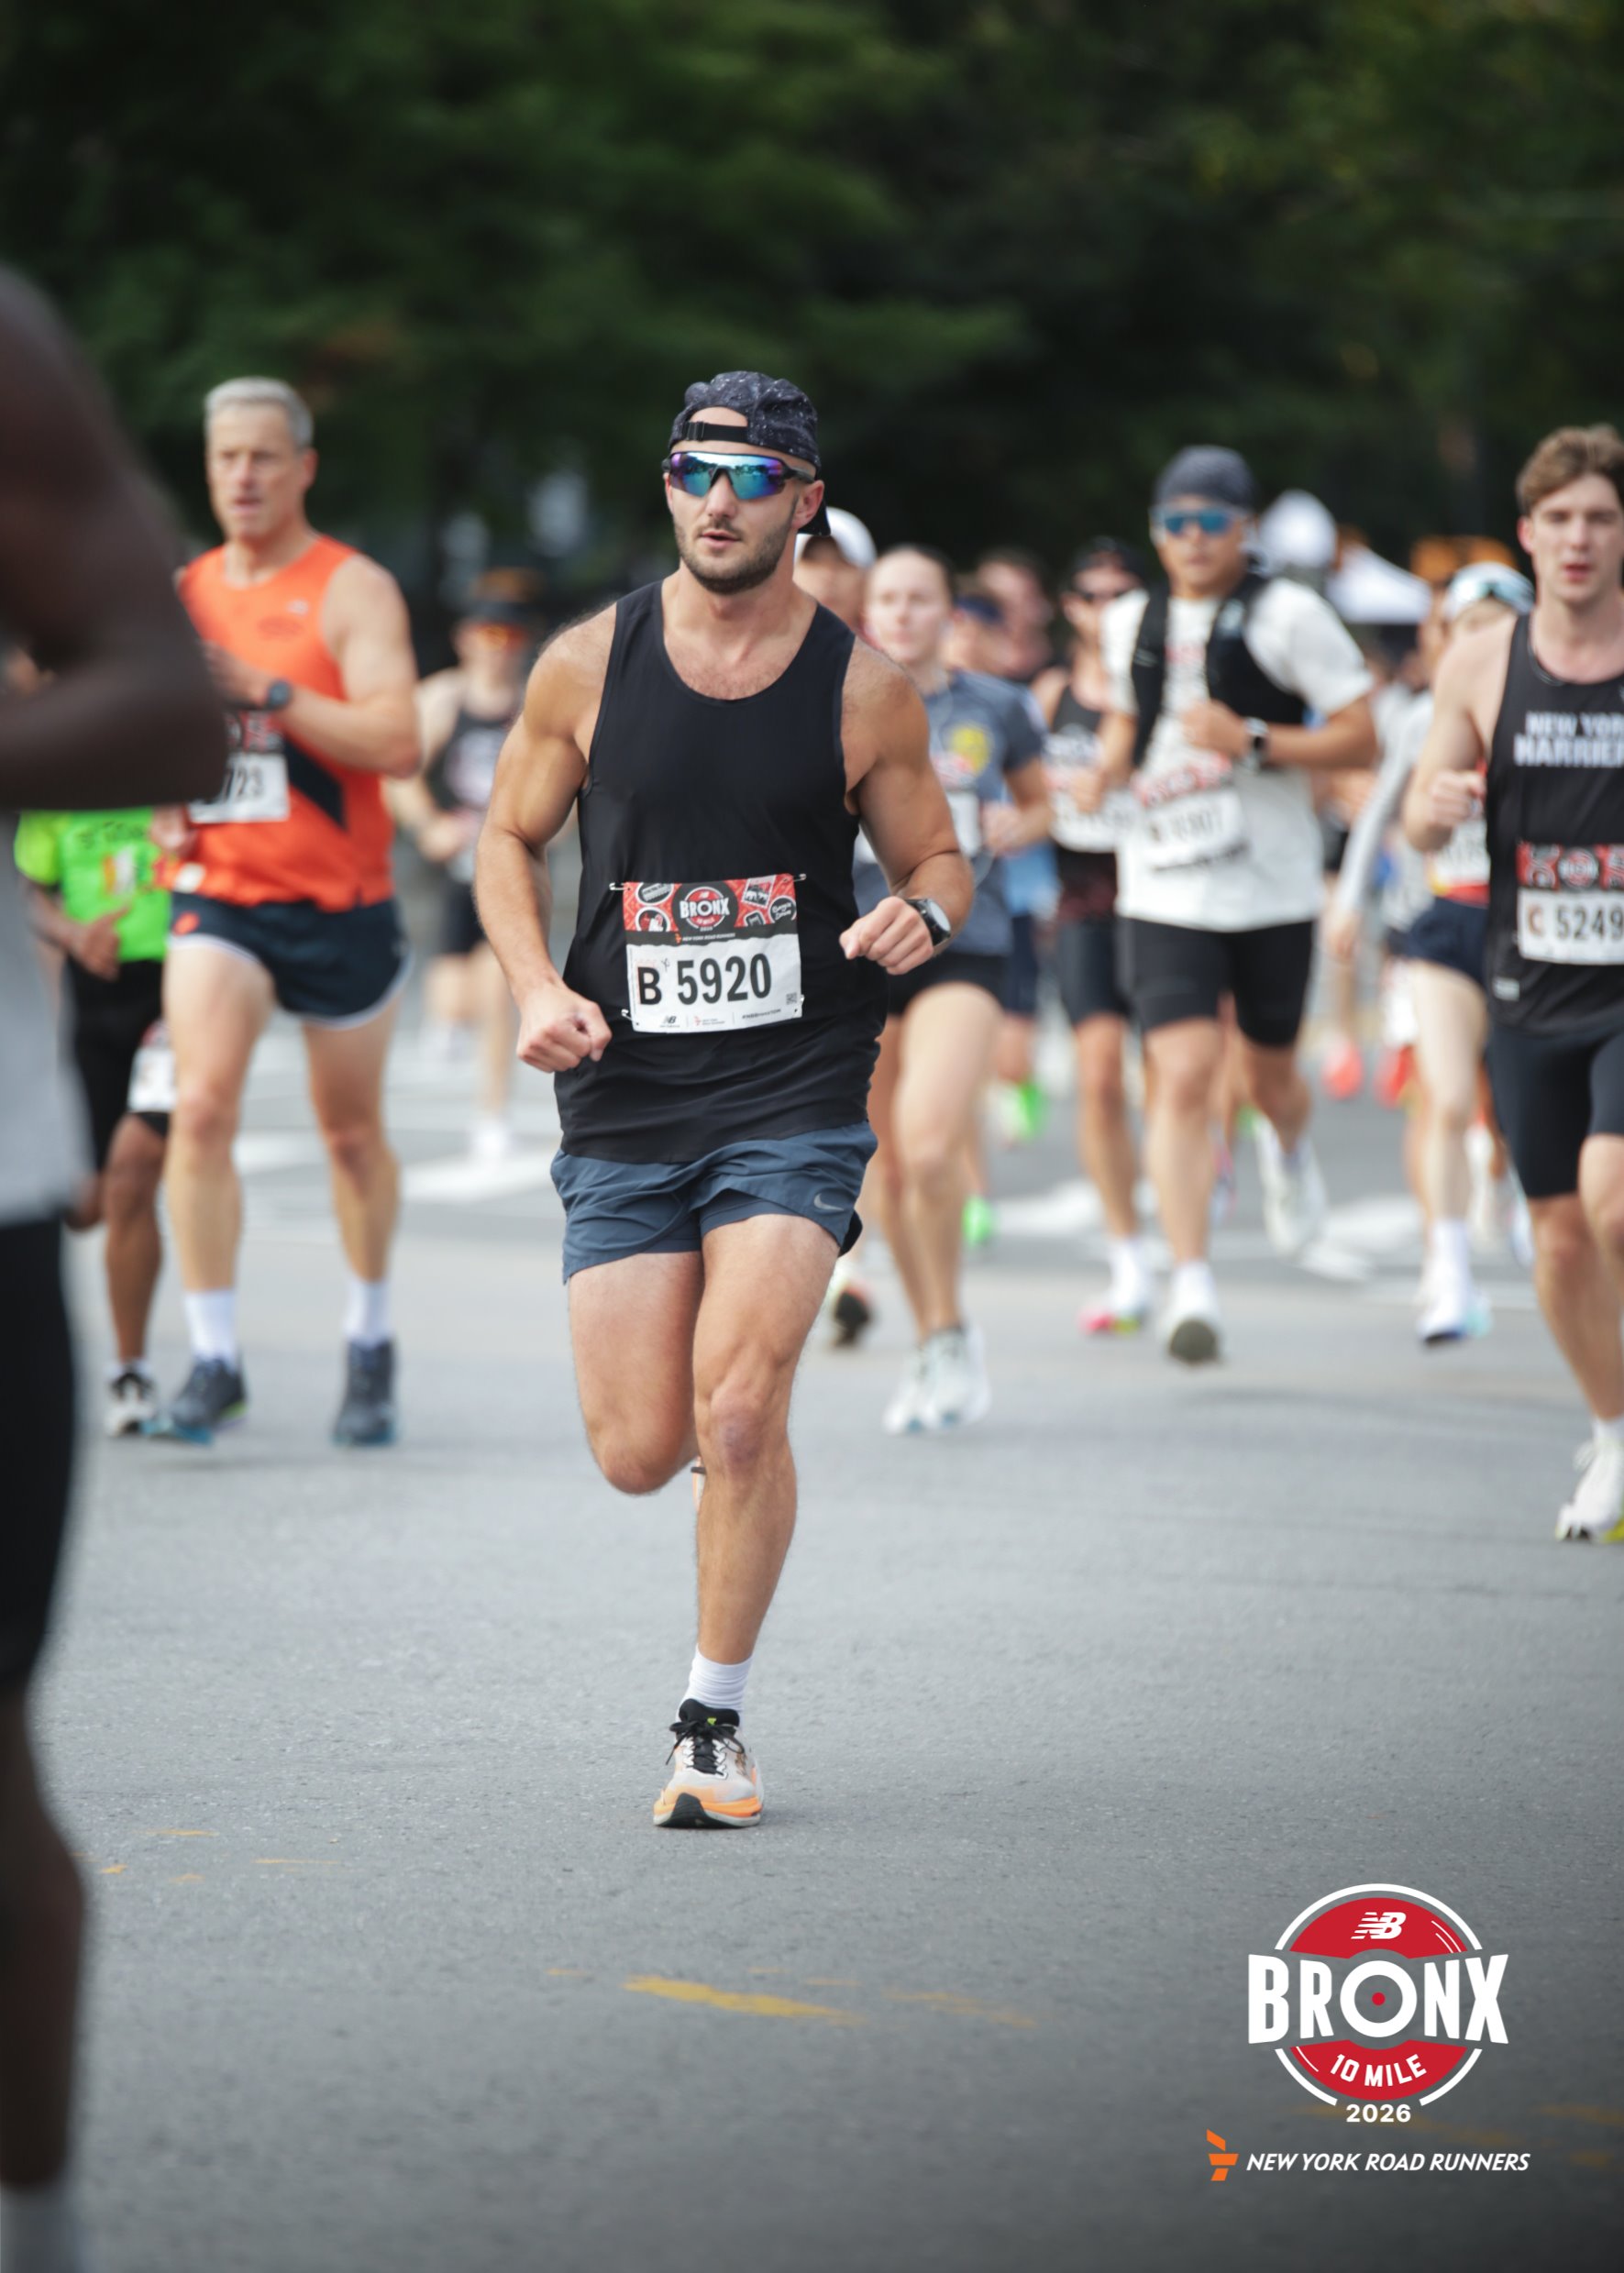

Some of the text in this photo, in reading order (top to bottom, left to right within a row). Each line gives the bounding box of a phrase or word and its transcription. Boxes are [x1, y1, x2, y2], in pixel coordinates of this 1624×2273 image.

[679, 898, 730, 919] BRONX
[1528, 905, 1544, 934] C
[637, 953, 772, 1006] B 5920
